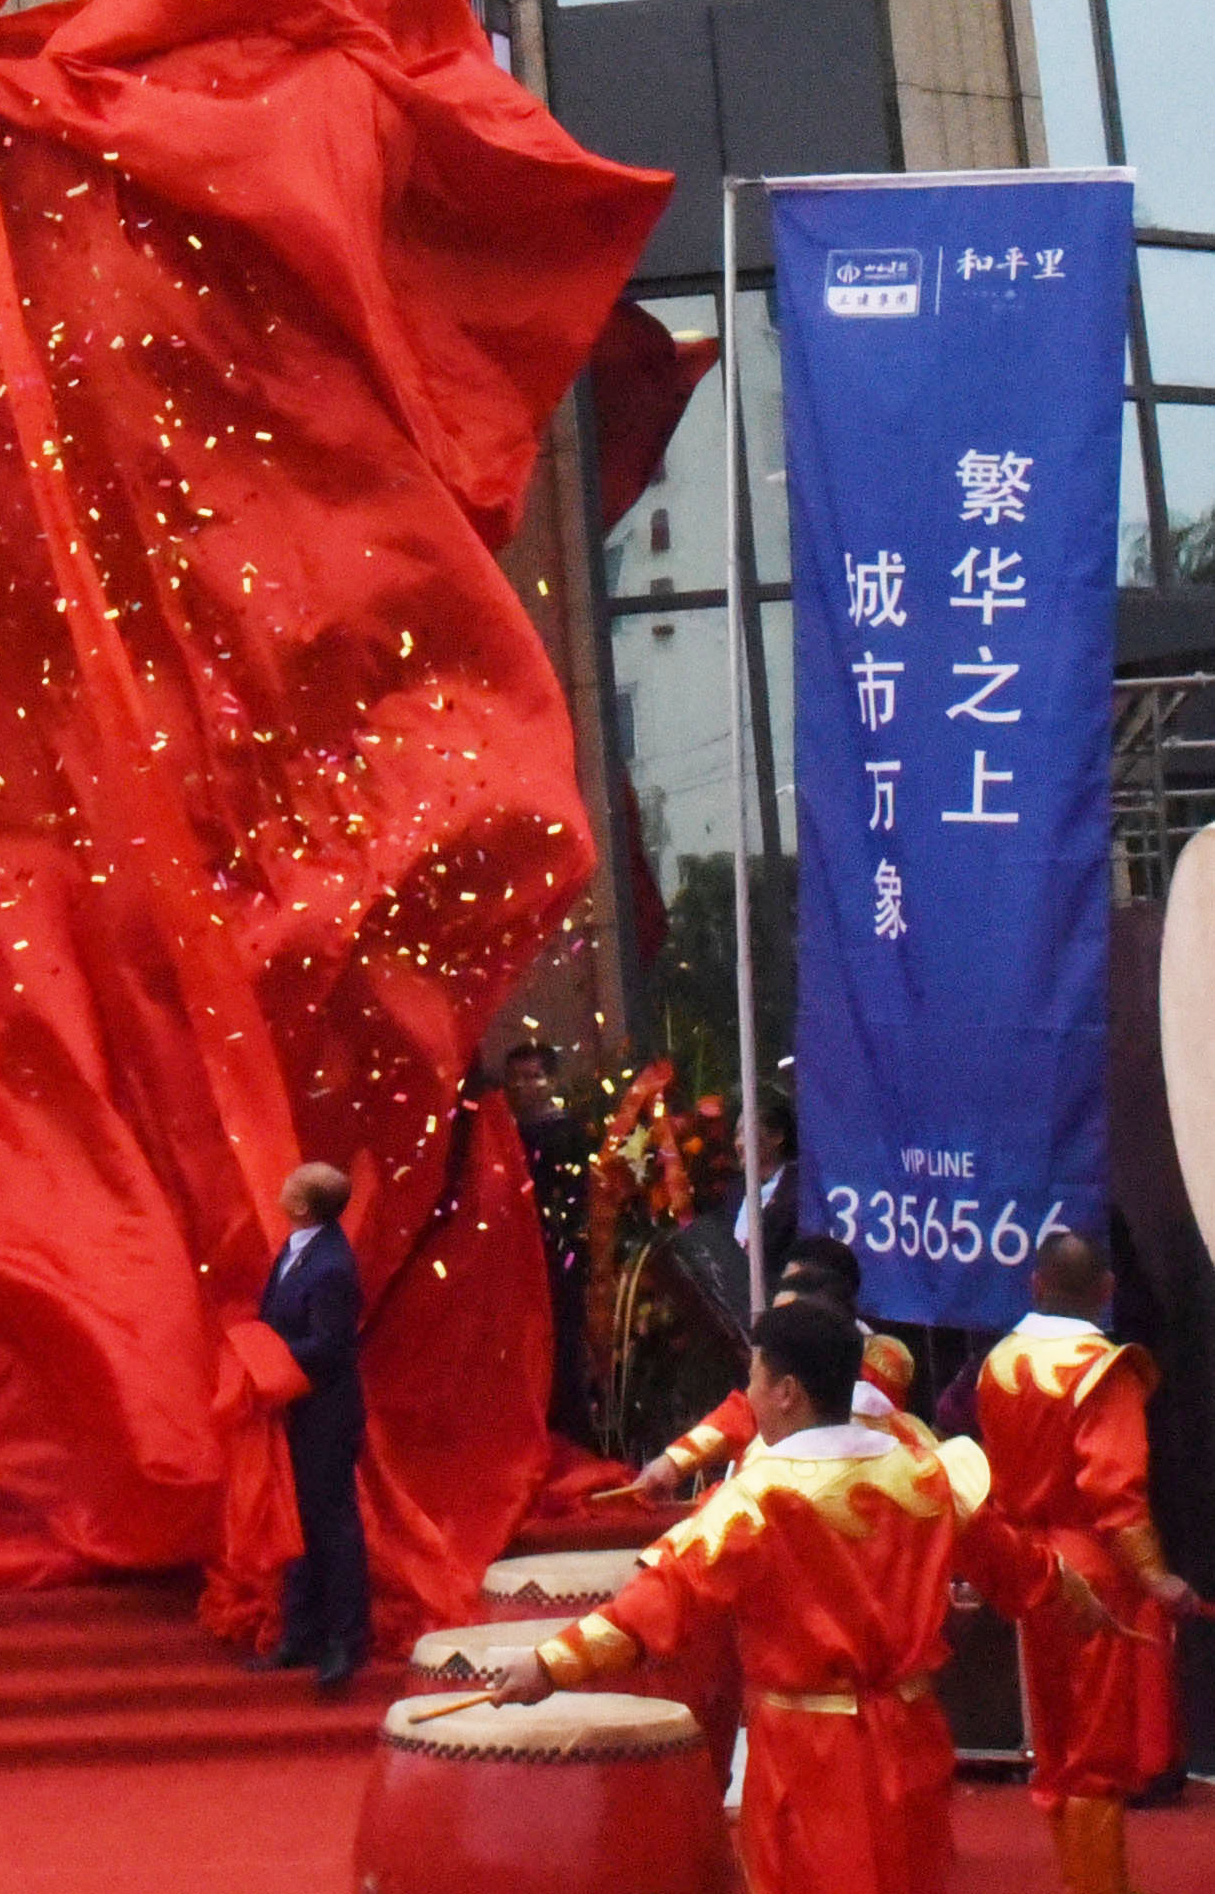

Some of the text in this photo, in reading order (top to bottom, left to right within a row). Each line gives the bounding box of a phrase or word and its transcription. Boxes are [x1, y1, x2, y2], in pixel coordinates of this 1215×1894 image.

[956, 246, 1066, 281] 和平里
[845, 549, 908, 941] 城市万象
[941, 448, 1034, 824] 繁华之上
